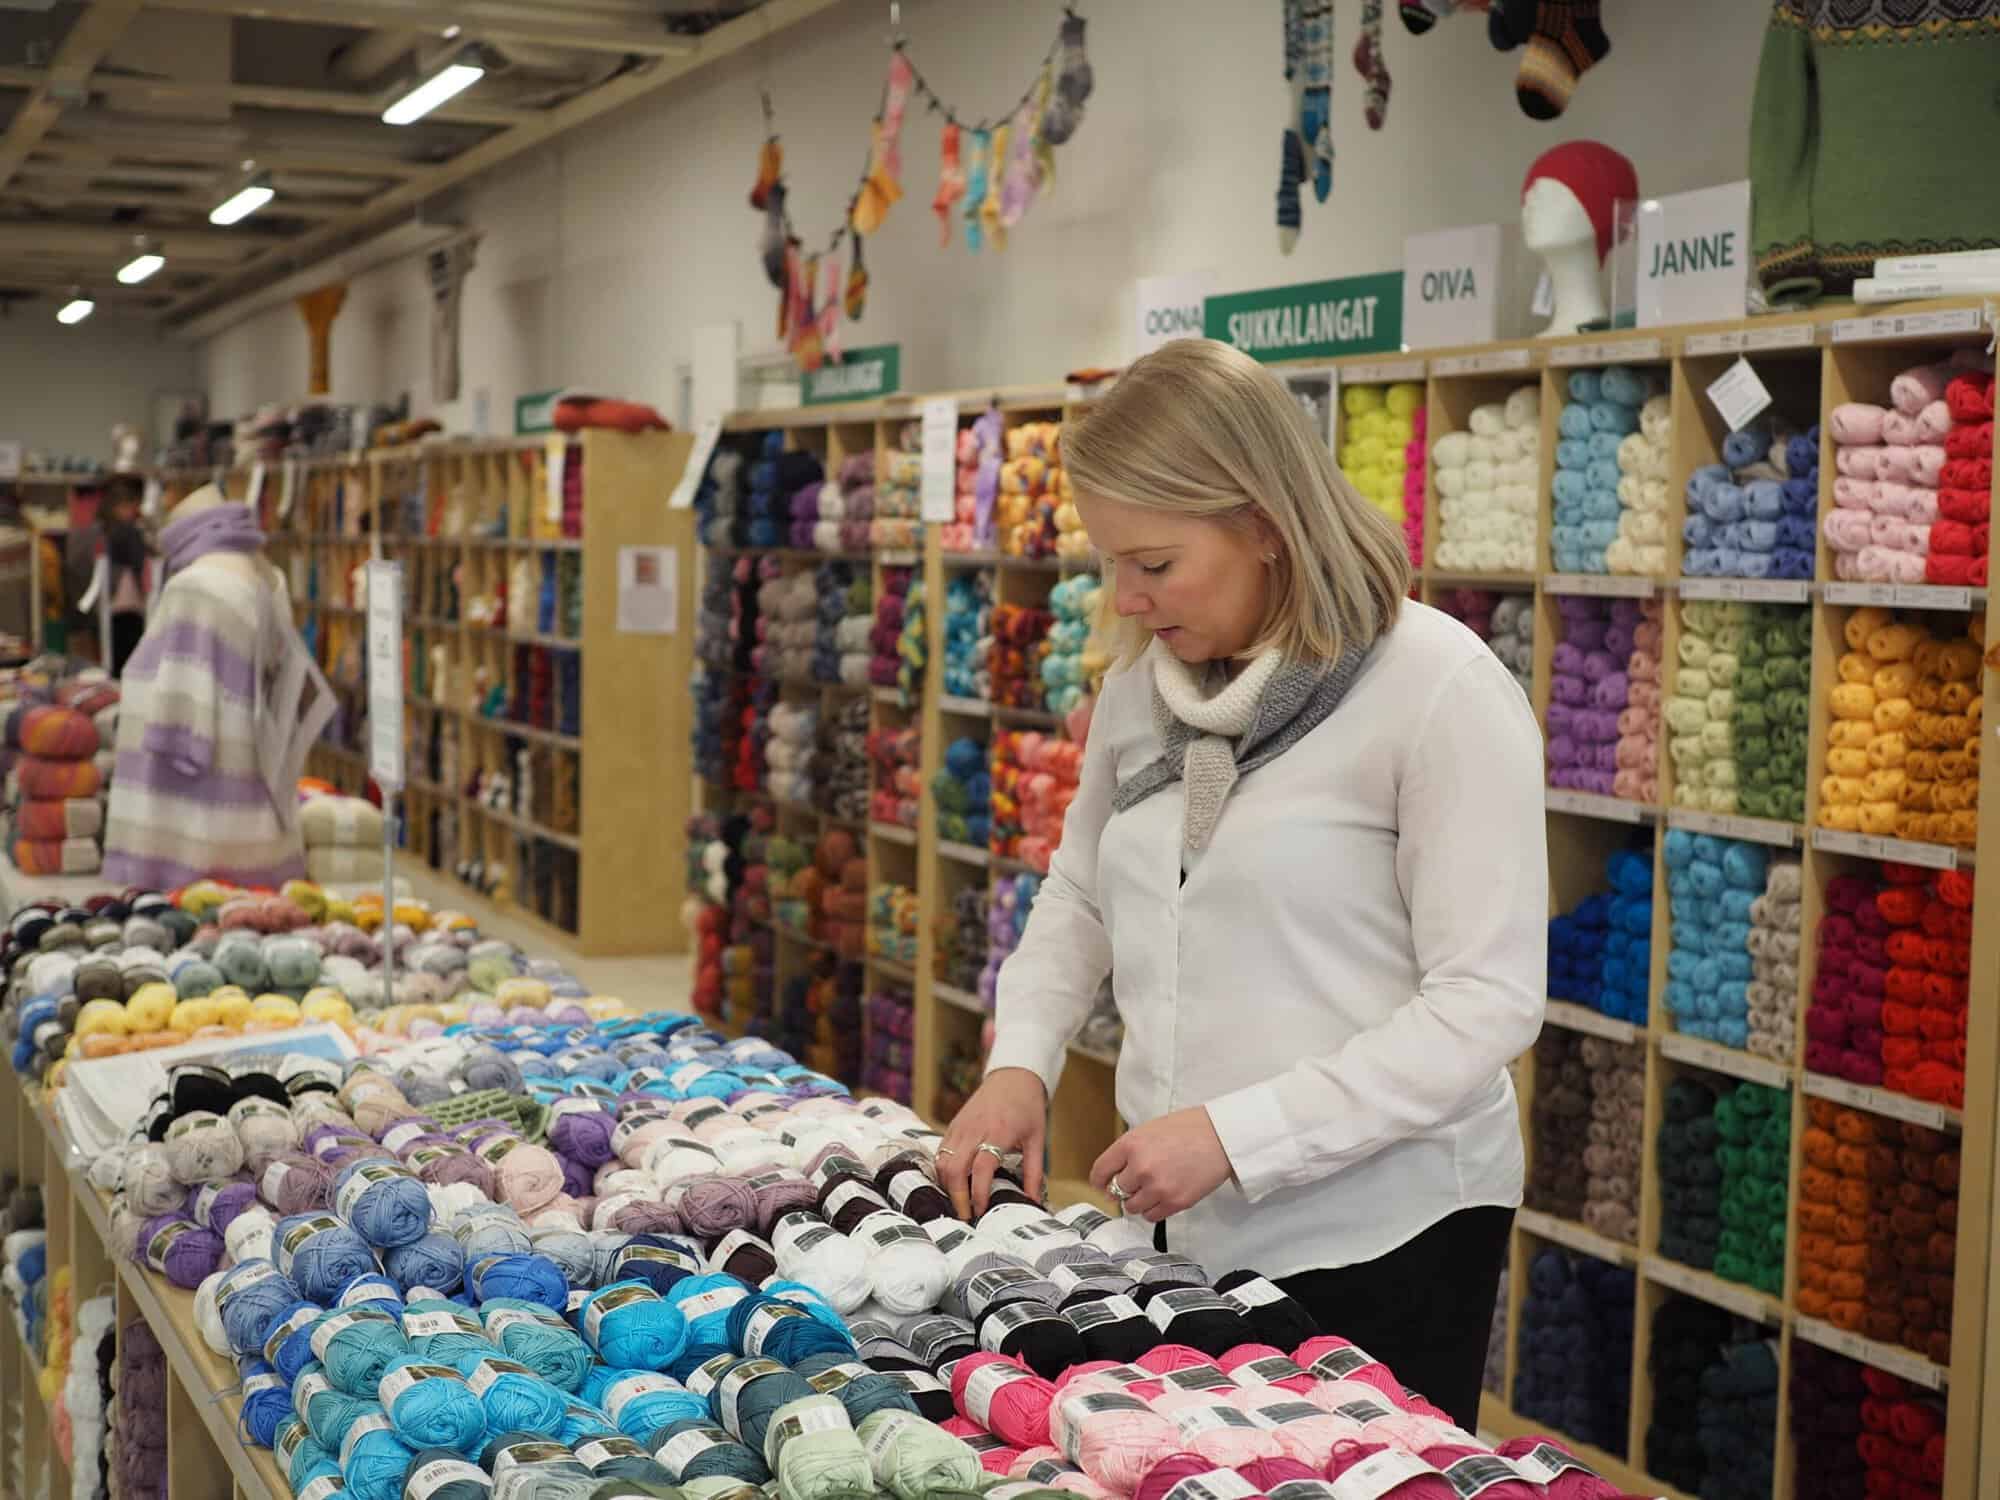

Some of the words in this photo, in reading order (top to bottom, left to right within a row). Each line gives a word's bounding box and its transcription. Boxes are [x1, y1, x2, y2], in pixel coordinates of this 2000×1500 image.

[1649, 232, 1735, 278] JANNE
[1421, 267, 1477, 302] OIVA
[1145, 305, 1204, 335] OONA
[1227, 295, 1379, 351] SUKKALANGAT
